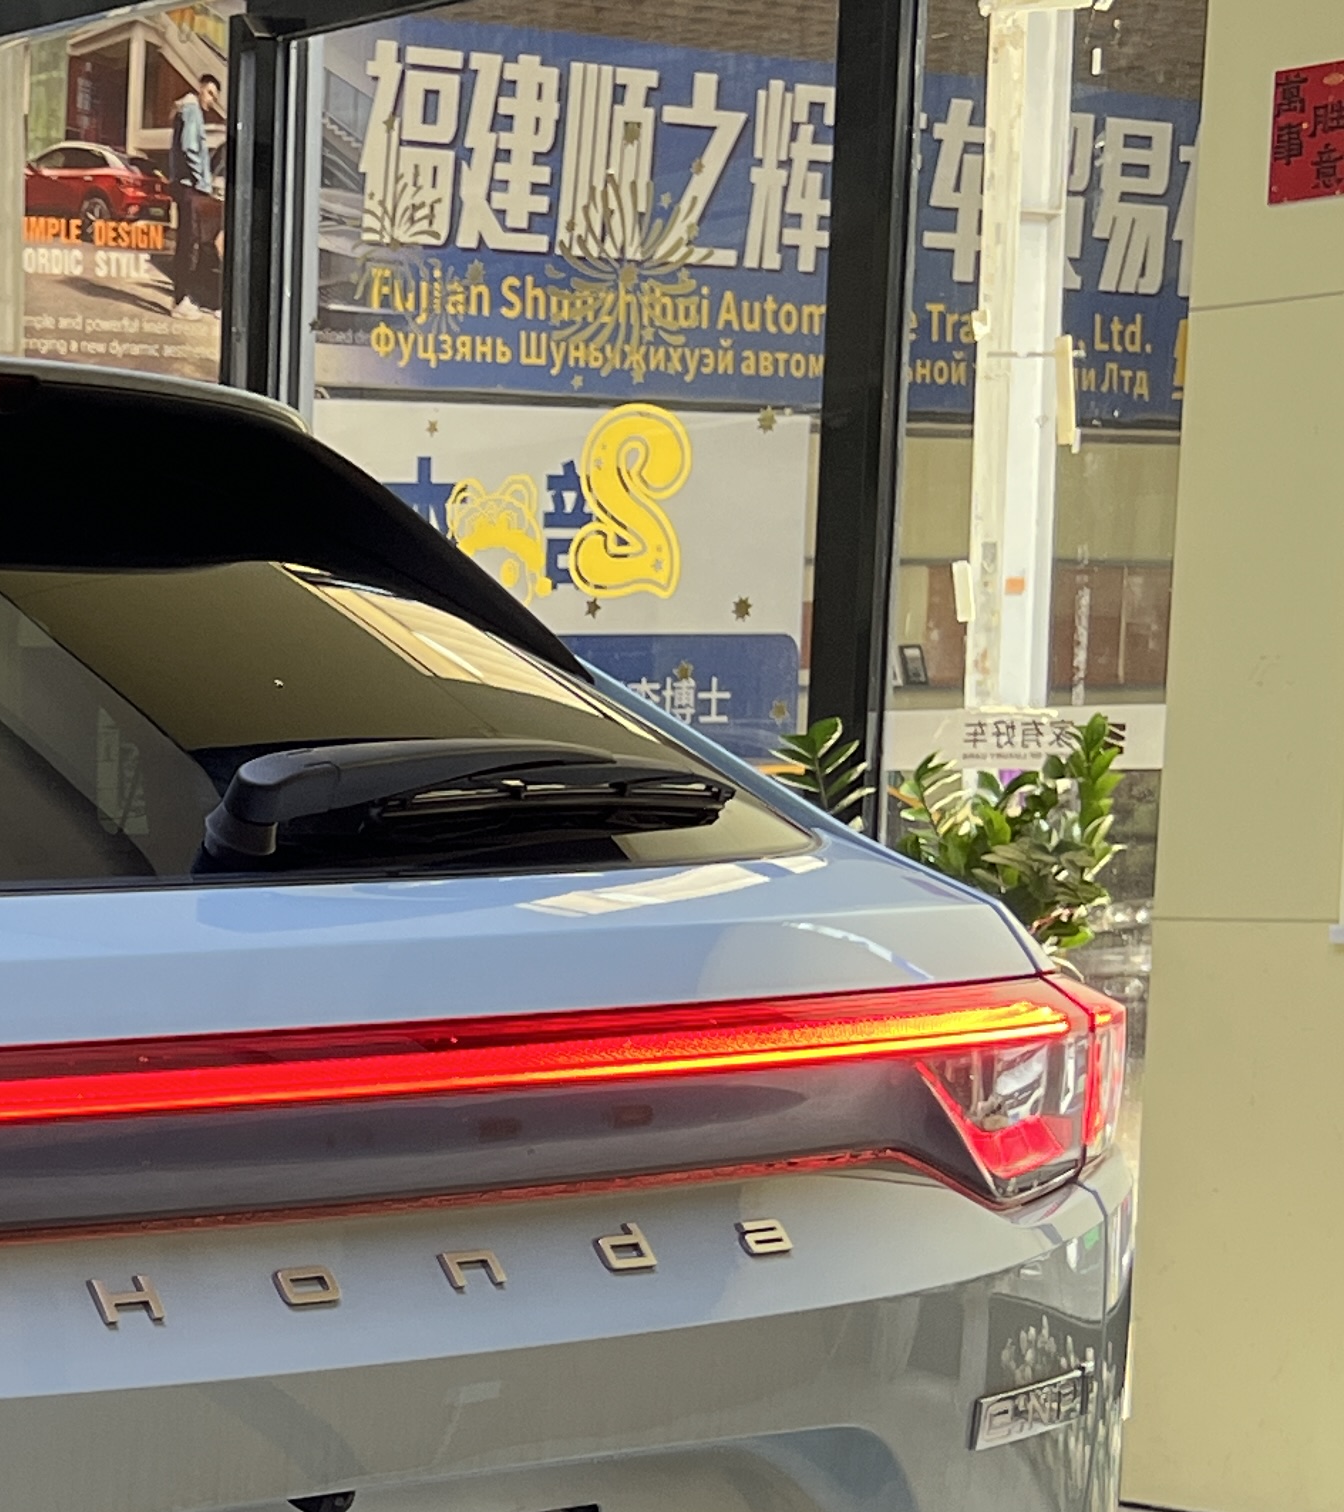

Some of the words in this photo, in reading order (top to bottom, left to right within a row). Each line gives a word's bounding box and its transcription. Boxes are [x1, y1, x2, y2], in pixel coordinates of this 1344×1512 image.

[23, 216, 83, 245] IMPLE
[94, 219, 165, 250] DESIGN
[23, 247, 84, 275] ORDIC
[95, 250, 151, 279] STYLE
[370, 265, 491, 325] Fujian
[1094, 312, 1152, 354] Ltd.
[369, 320, 513, 369] Фуцзянь
[1100, 361, 1150, 402] Лтд
